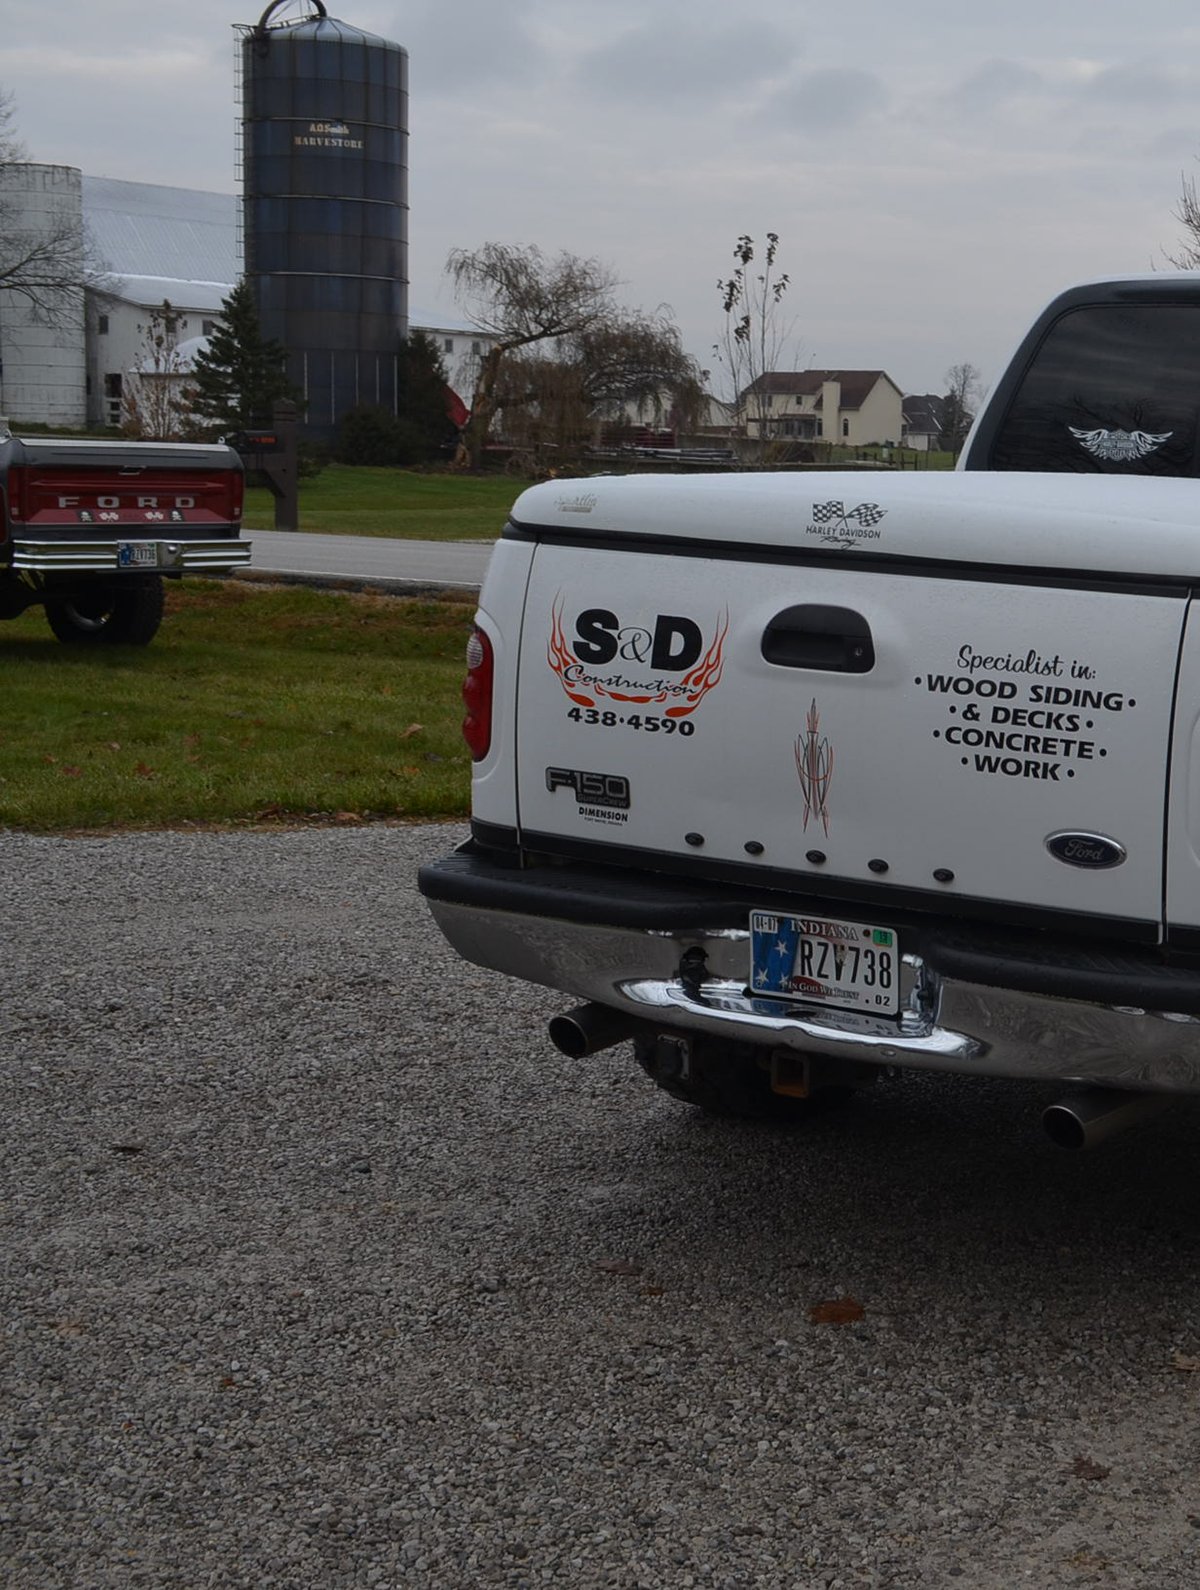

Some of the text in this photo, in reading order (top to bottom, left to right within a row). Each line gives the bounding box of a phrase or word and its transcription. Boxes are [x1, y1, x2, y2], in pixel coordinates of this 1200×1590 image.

[294, 136, 364, 149] HARVESTORE
[58, 496, 195, 509] FORD
[806, 525, 881, 539] HARLEY DAVIDSON
[572, 608, 703, 672] S&D
[957, 644, 1097, 679] Specialist in:
[563, 664, 696, 695] Construction
[927, 674, 1124, 712] WOOD SIDING
[961, 703, 1080, 732] & DECKS
[945, 726, 1095, 760] CONCRETE
[974, 754, 1061, 781] WORK
[578, 806, 629, 822] DIMENSION
[1064, 838, 1105, 860] Ford
[789, 919, 860, 941] INDIANA
[800, 939, 892, 989] RZV738
[799, 982, 818, 993] GOD
[875, 994, 890, 1007] 02
